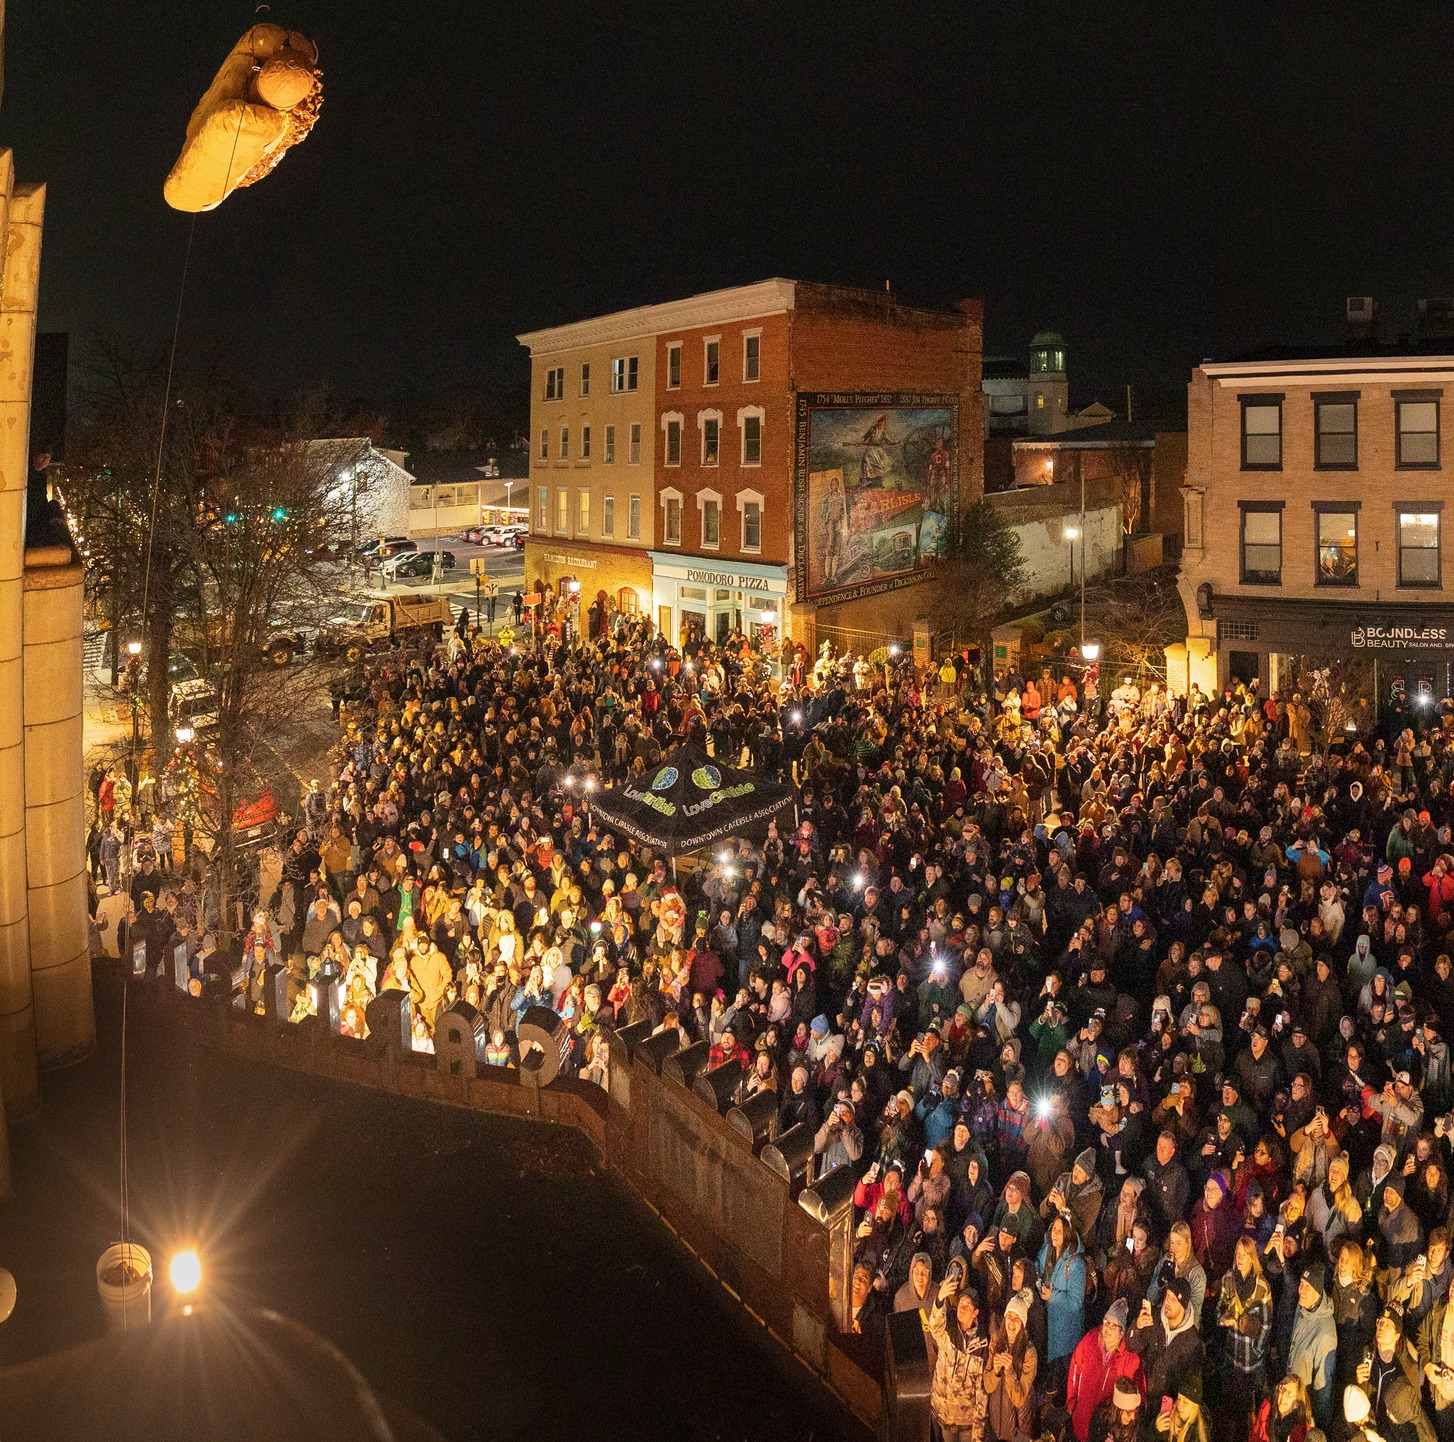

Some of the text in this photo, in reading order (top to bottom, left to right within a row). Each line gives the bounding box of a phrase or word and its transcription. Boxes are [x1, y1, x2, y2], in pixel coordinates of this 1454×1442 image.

[798, 421, 806, 466] BENJAMIN
[859, 493, 921, 513] CARLISLE
[687, 569, 770, 591] POMODORO PIZZA
[798, 545, 806, 602] DECLARATION
[860, 584, 888, 597] FOUNDER
[1367, 627, 1447, 639] BOUNDLESS
[1367, 639, 1408, 648] BEAUTY
[681, 795, 794, 848] DOWNTOWN CARLISLE ASSOCIATION
